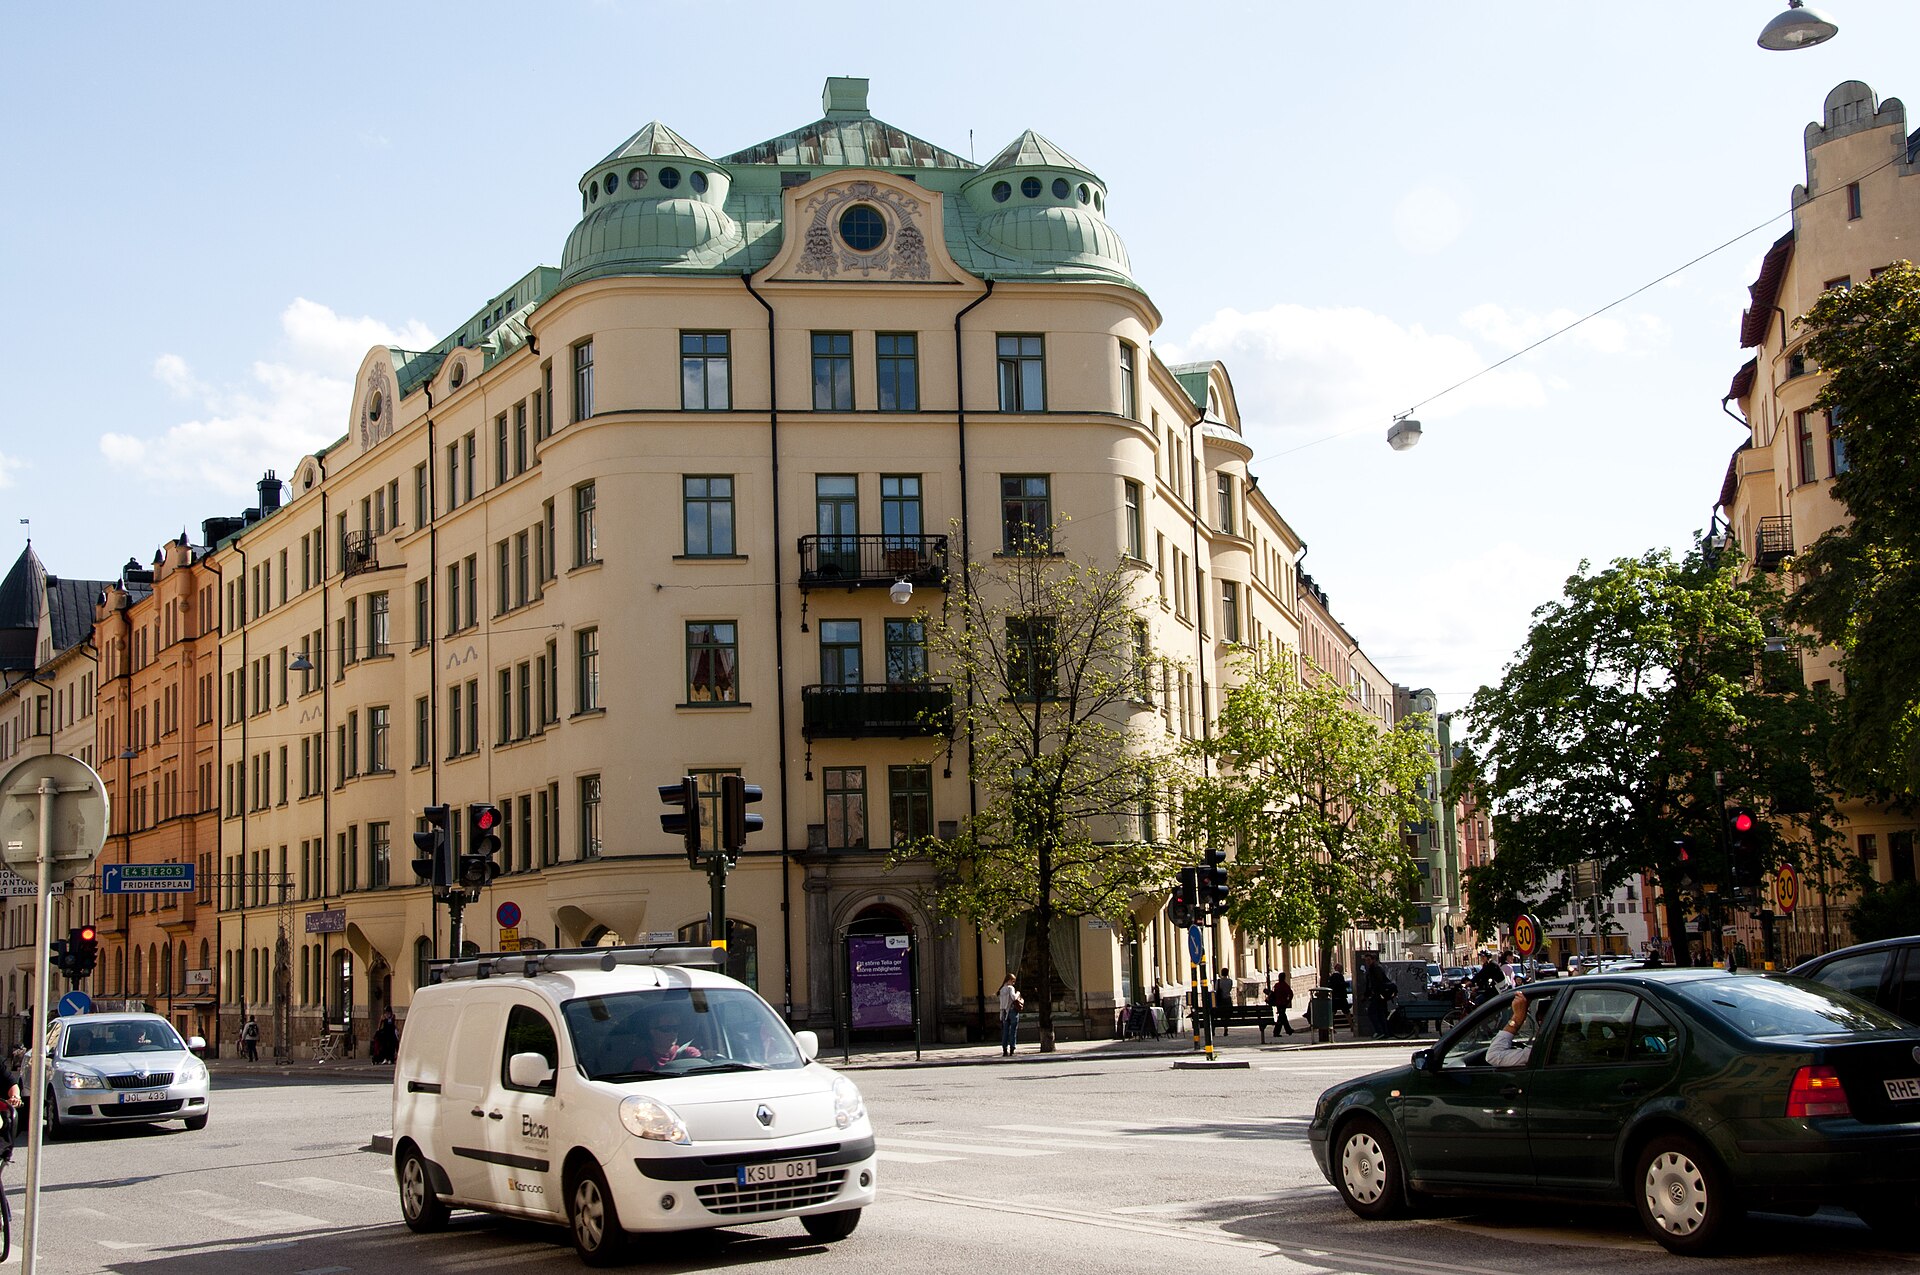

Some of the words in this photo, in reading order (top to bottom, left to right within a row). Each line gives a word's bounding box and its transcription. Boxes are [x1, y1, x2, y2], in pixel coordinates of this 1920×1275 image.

[12, 886, 63, 894] ERIKSAN
[123, 881, 189, 889] FRIDHEMSPLAN
[1779, 876, 1794, 900] 30
[1517, 926, 1532, 945] 30
[149, 1092, 165, 1100] 433
[1886, 1080, 1919, 1098] RHE
[747, 1165, 776, 1182] KSU
[786, 1161, 812, 1178] 081
